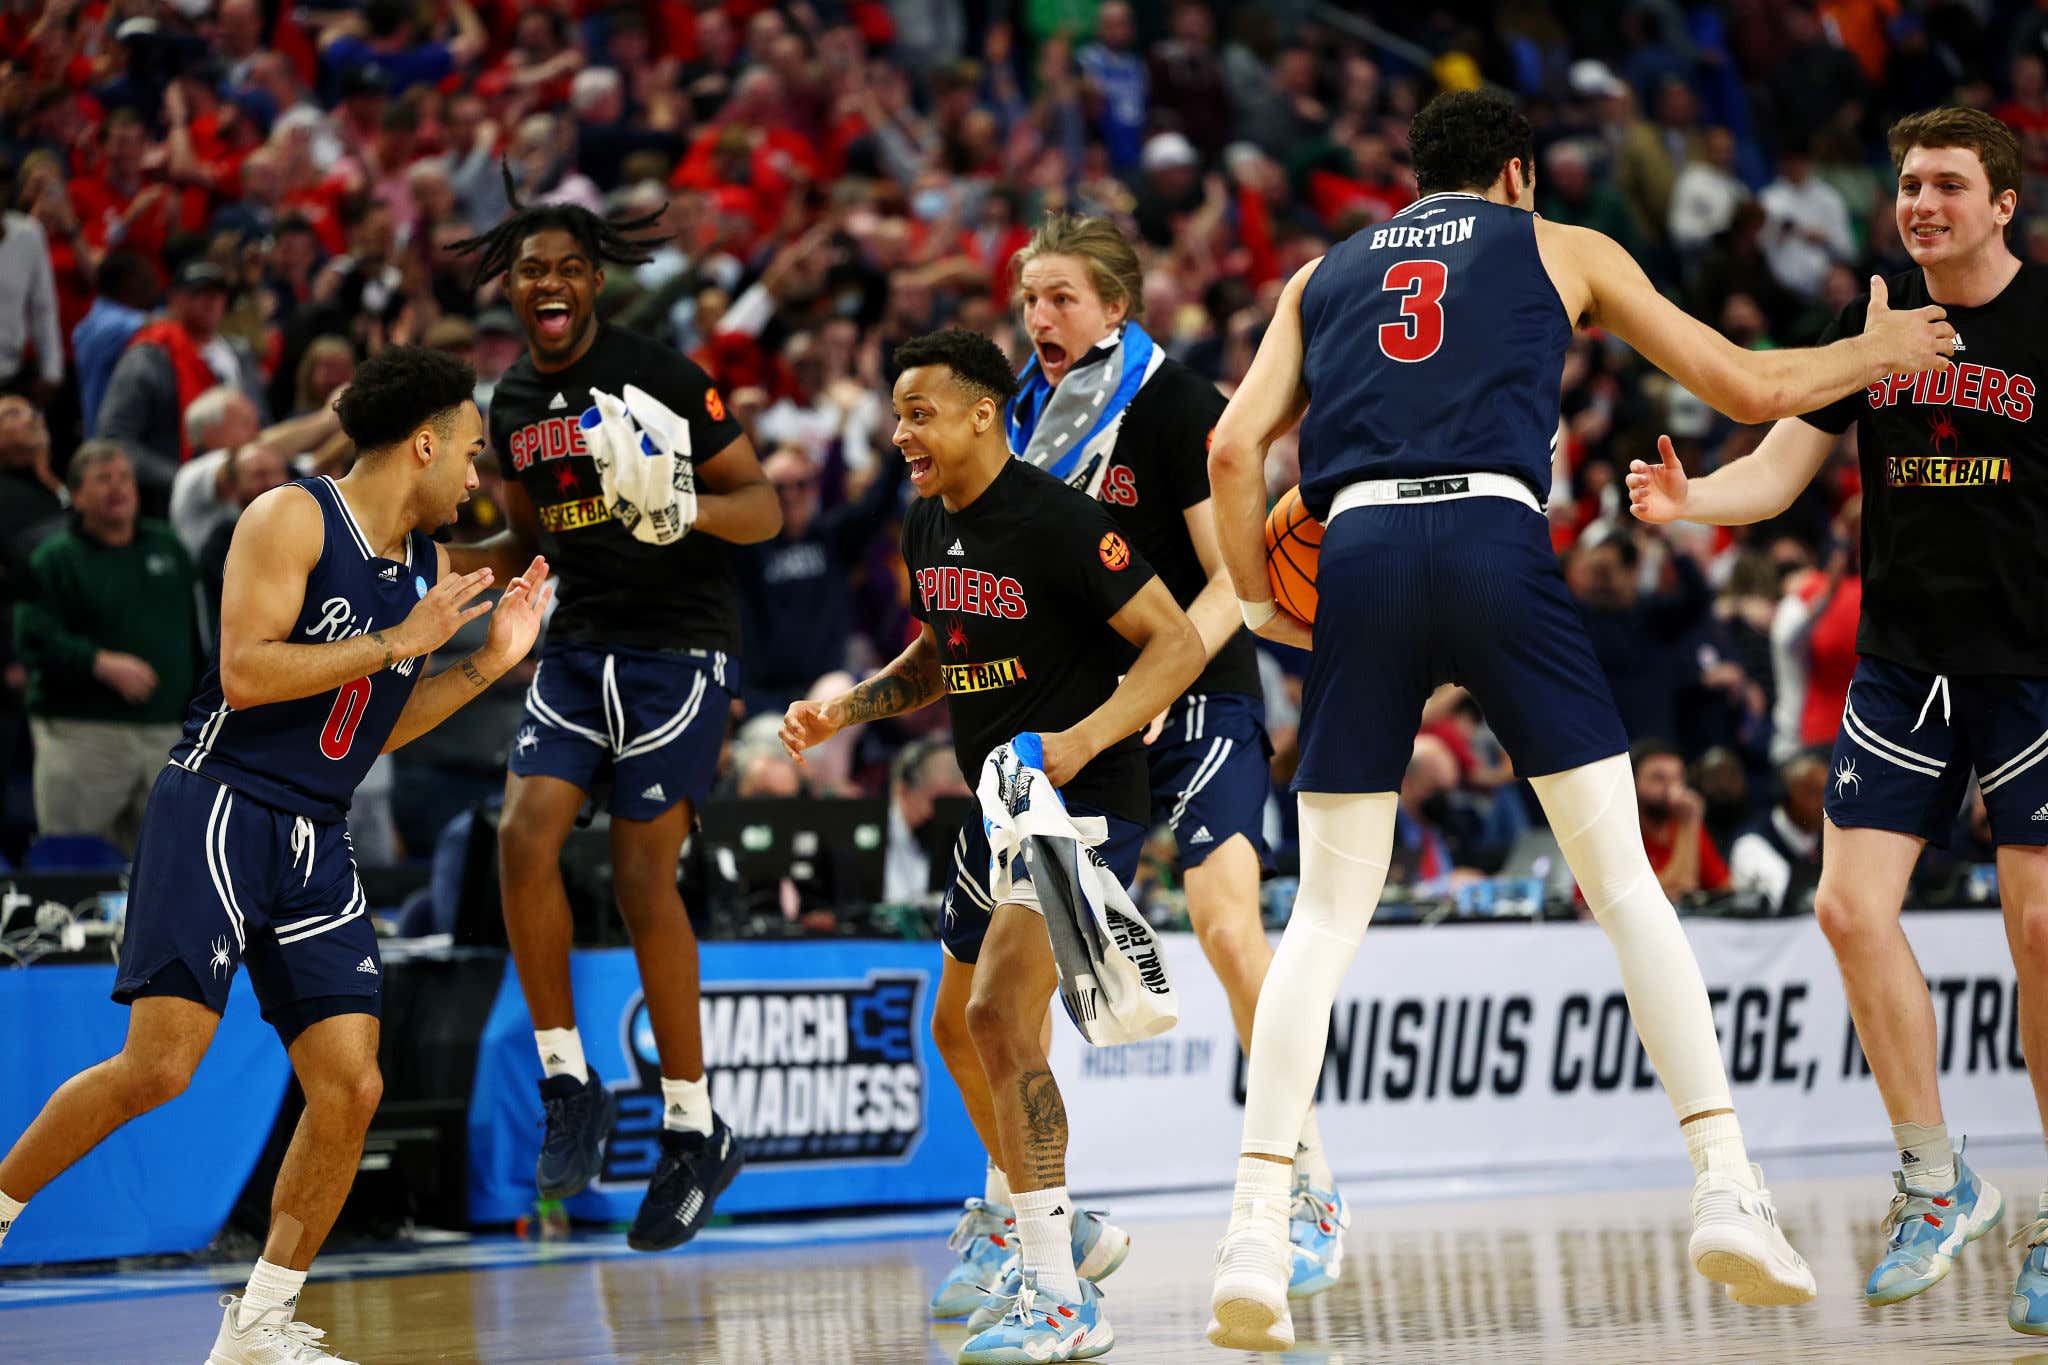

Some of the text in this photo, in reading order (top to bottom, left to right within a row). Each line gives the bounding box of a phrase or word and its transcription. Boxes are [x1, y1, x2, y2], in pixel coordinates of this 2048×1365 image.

[1370, 216, 1476, 250] BURTON
[1378, 259, 1448, 363] 3
[510, 416, 590, 472] SPIDE
[1888, 457, 2011, 486] BASKETBALL
[916, 567, 1028, 620] SPIDERS
[320, 676, 372, 760] 0
[1136, 947, 1170, 994] FINAL
[700, 993, 848, 1066] MARCH
[711, 1063, 921, 1138] MADNESS
